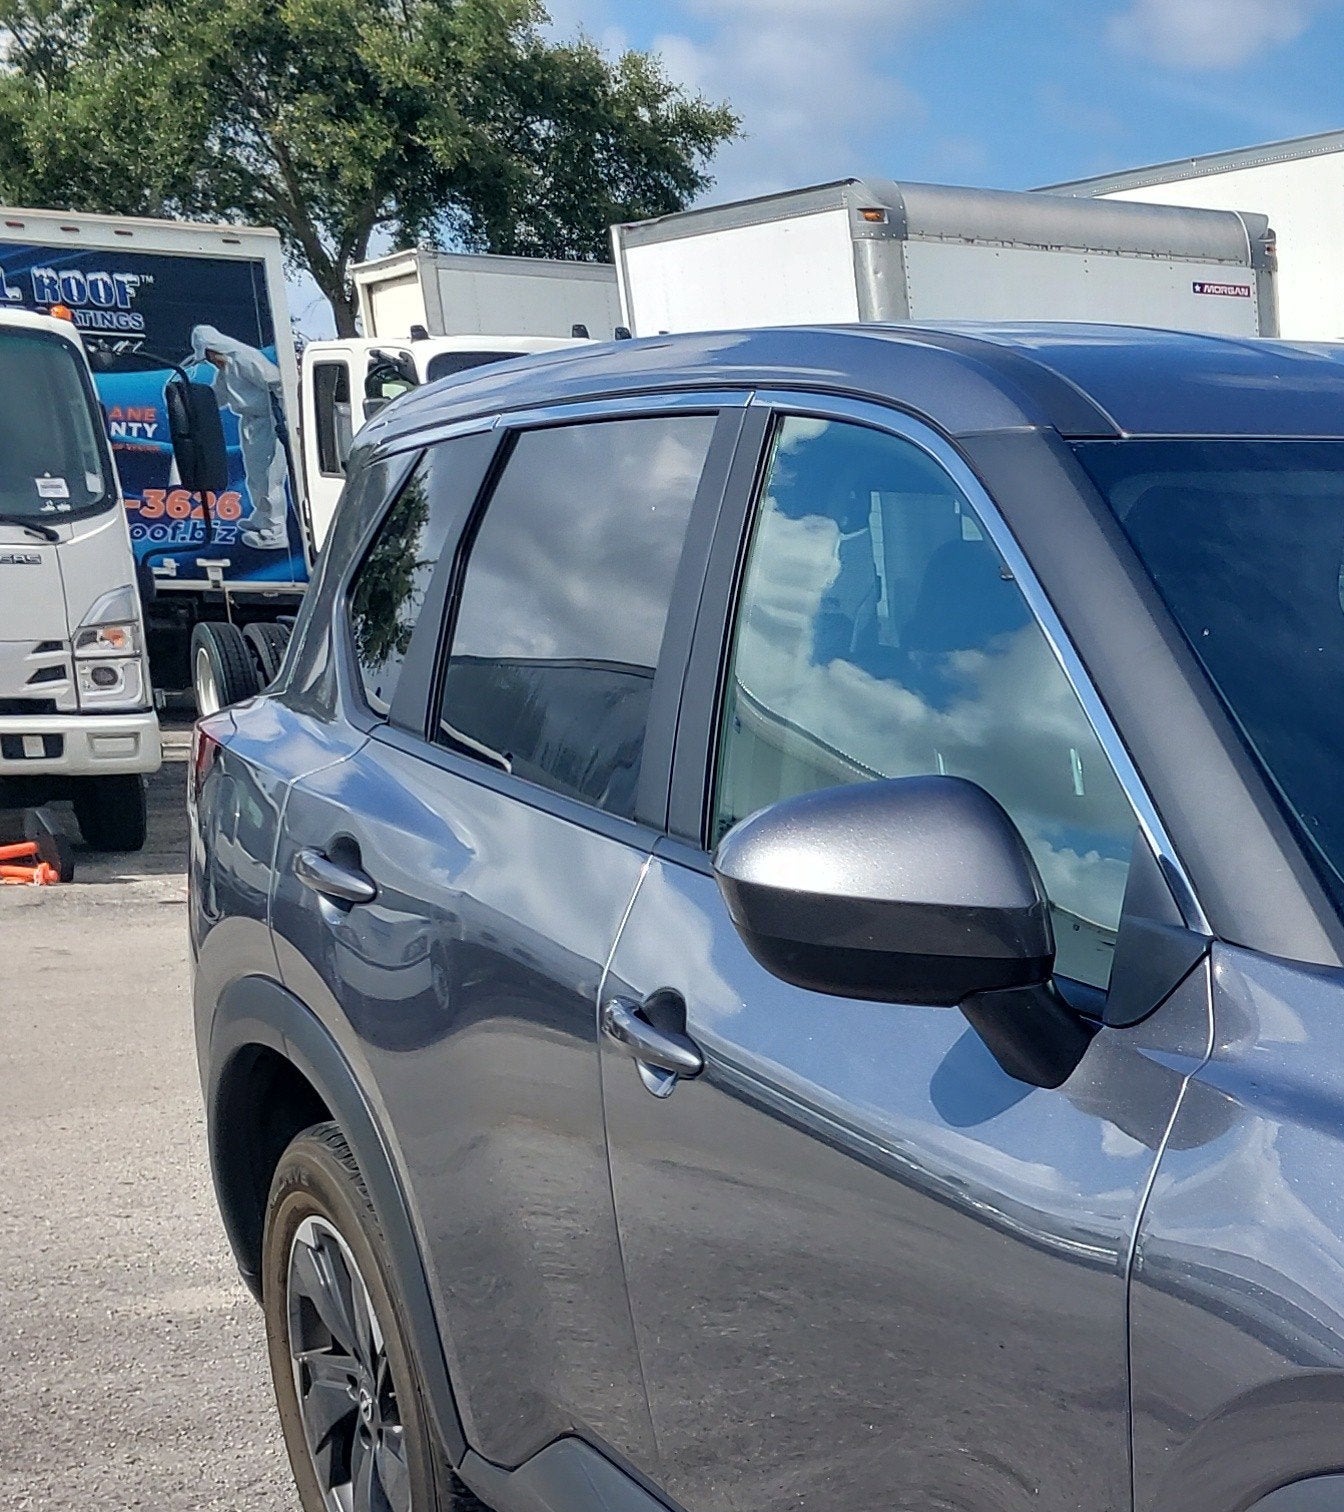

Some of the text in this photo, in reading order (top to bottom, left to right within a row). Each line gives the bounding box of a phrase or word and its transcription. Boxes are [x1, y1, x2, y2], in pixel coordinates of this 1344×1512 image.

[31, 266, 139, 309] ROOF
[1203, 284, 1249, 296] MORGAN
[110, 421, 158, 438] NTY
[124, 488, 242, 520] -3626
